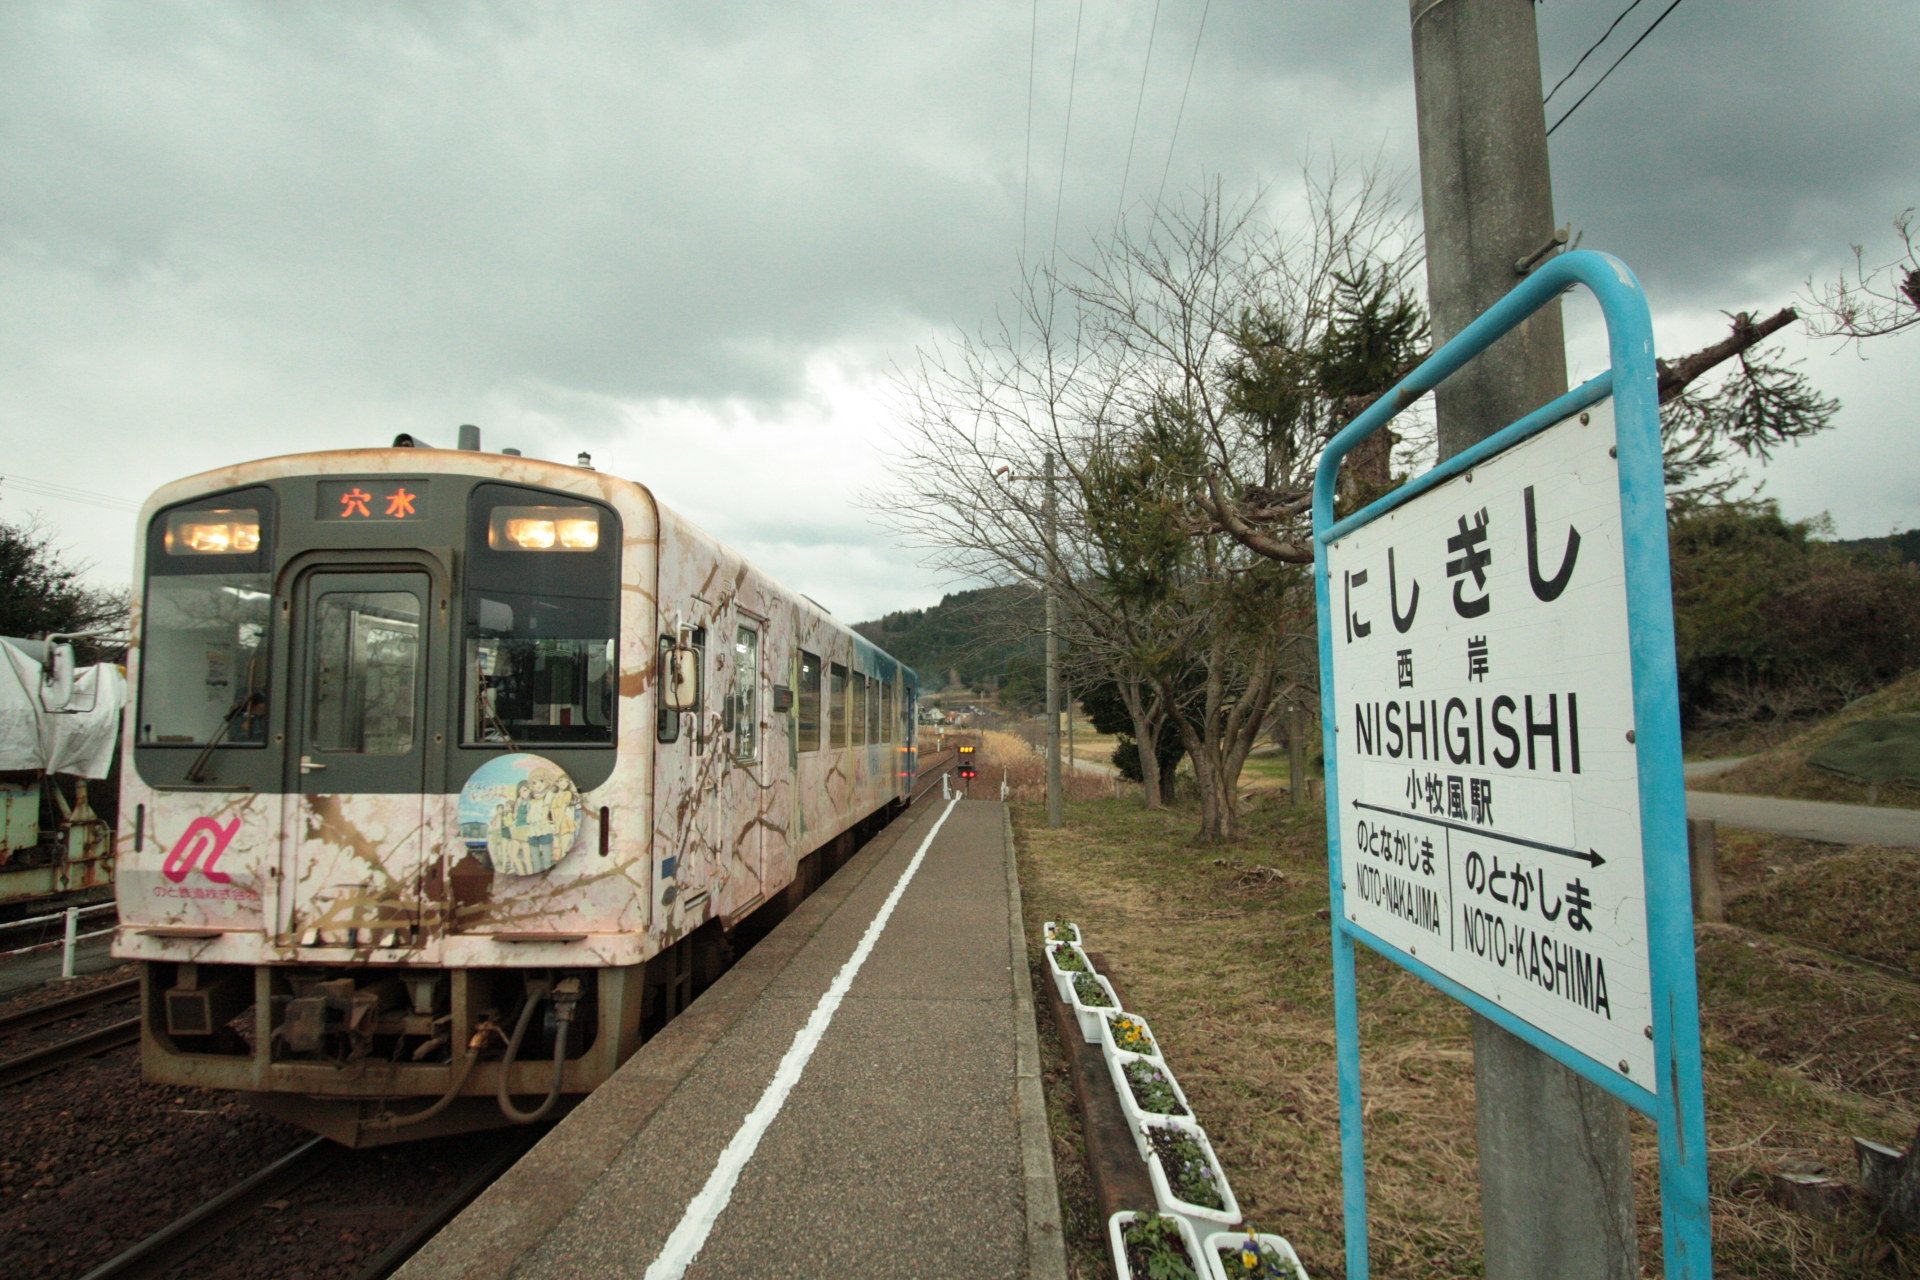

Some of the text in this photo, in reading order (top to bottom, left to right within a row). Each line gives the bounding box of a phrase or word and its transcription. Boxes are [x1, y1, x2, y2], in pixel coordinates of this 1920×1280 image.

[340, 488, 416, 518] 穴水
[1344, 485, 1581, 644] にしぎし
[1396, 635, 1489, 689] 西岸
[1355, 692, 1581, 774] NISHIGISHI
[1405, 768, 1494, 826] 小牧風駅
[1357, 820, 1435, 876] のとなかじま
[1356, 862, 1441, 936] NOTO-NAKAJIMA
[1465, 850, 1592, 933] のとかしま
[1463, 903, 1611, 1020] NOTO-KASHIMA
